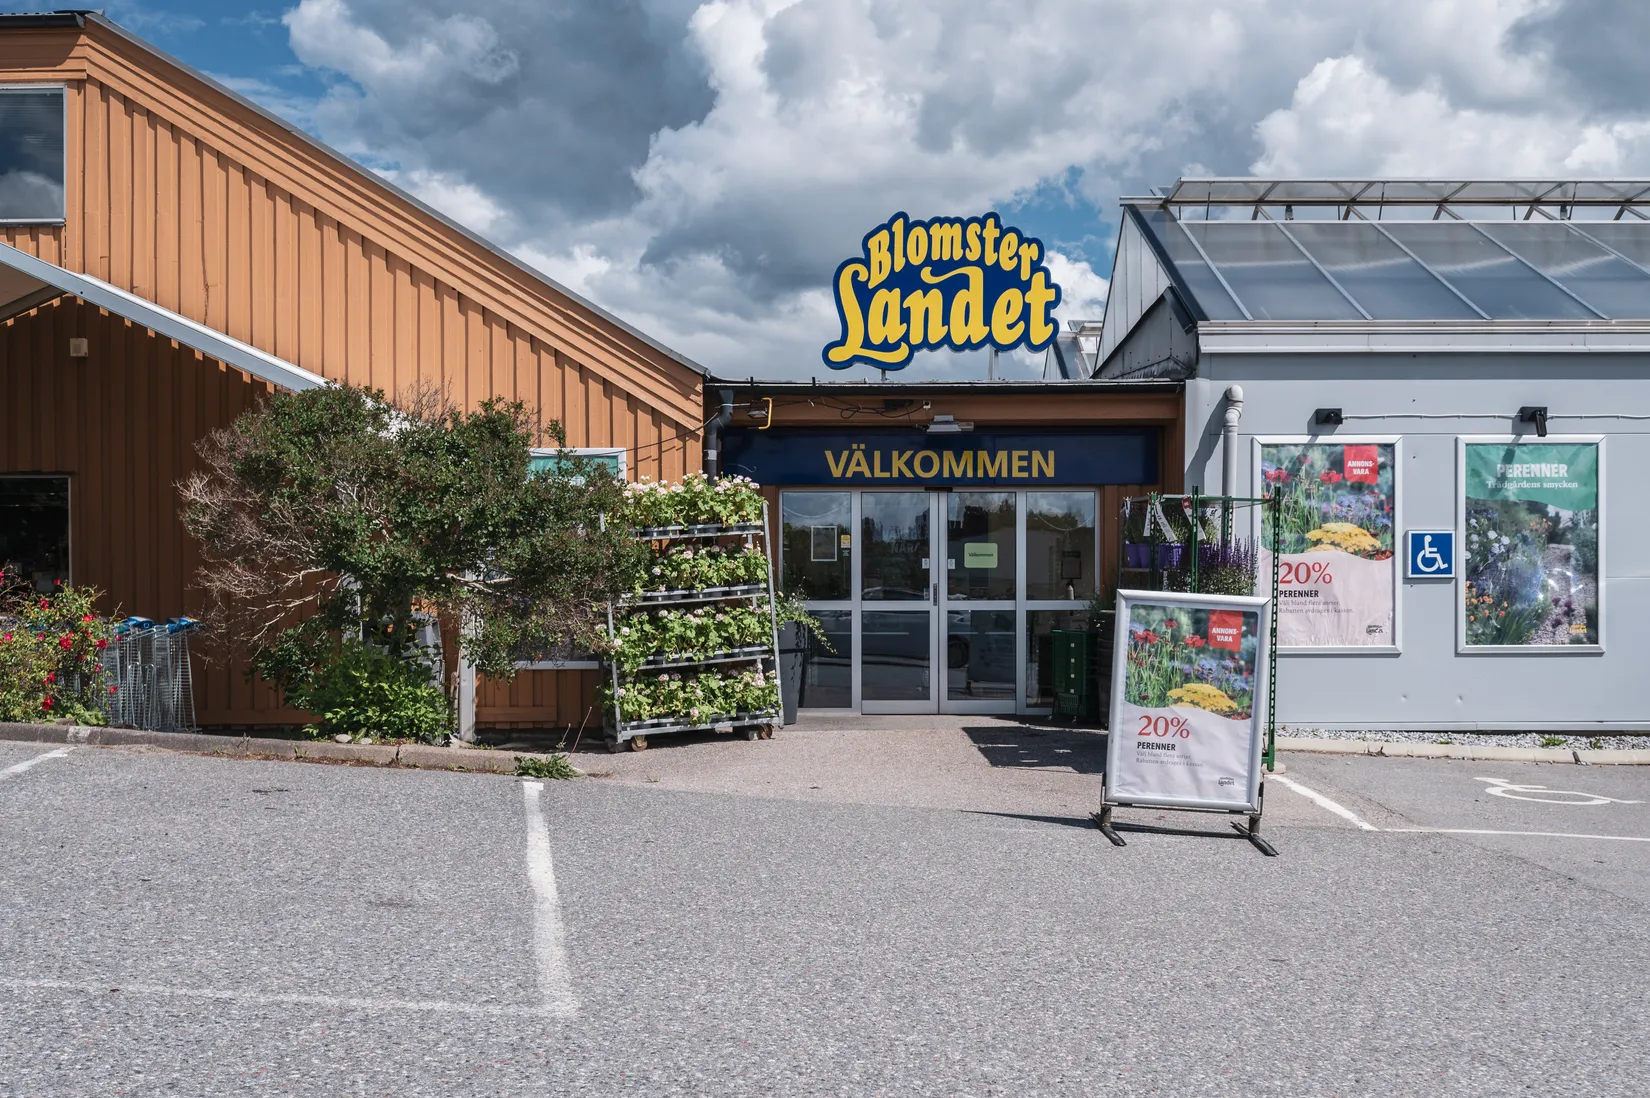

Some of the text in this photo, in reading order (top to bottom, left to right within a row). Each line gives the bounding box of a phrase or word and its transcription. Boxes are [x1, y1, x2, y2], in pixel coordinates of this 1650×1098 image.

[868, 217, 1038, 289] Blomster
[828, 264, 1055, 363] Landet
[824, 444, 1055, 478] VÄLKOMMEN
[1496, 463, 1568, 478] PERENNER
[1486, 480, 1578, 490] Trädgårdens smycken
[1279, 562, 1332, 584] 20%
[1279, 589, 1319, 598] PERENNER
[1137, 715, 1190, 739] 20%
[1137, 741, 1176, 751] PERENNER
